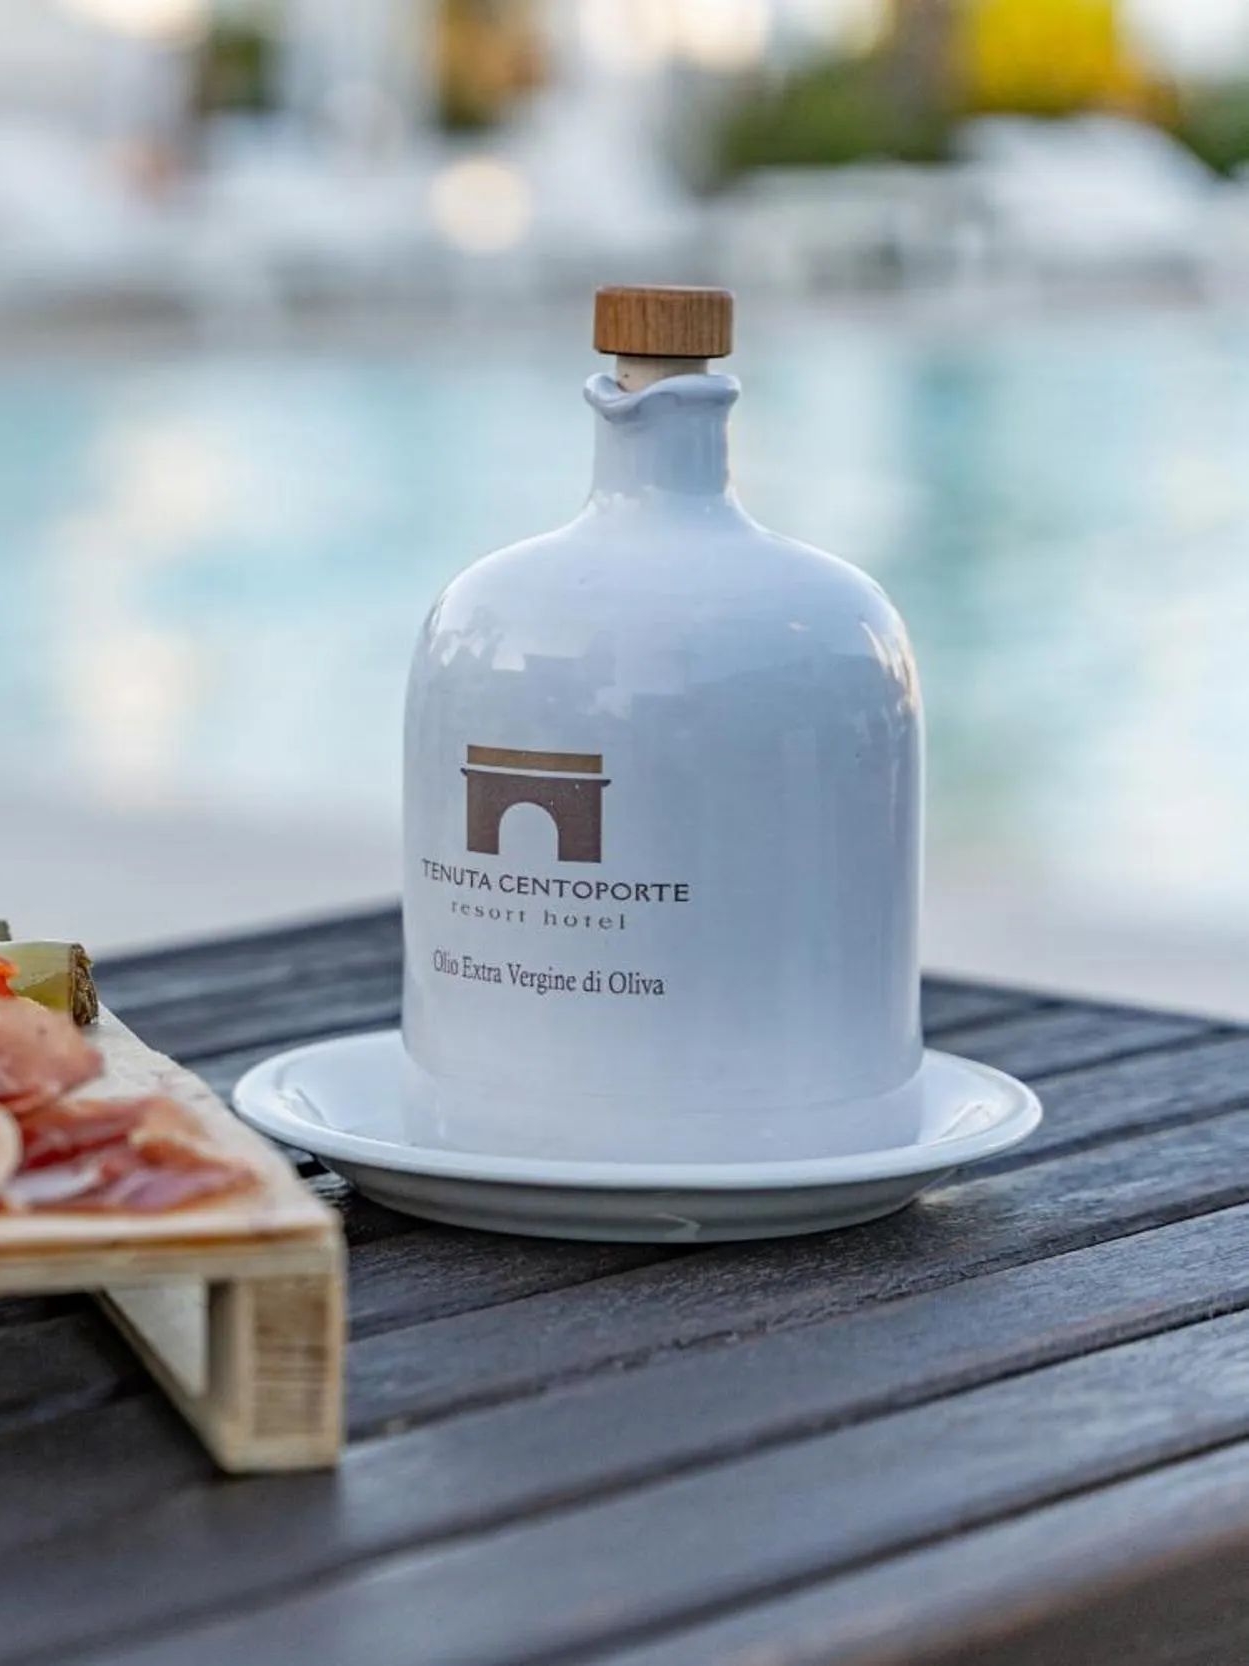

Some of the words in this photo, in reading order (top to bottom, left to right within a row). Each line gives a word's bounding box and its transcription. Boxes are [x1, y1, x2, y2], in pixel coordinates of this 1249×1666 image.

[422, 858, 491, 891] TENUTA
[499, 873, 690, 902] CENTOPORTE
[451, 901, 525, 923] resort
[543, 909, 626, 930] hotel
[433, 949, 459, 976] Olio
[462, 956, 502, 983] Extra
[507, 963, 577, 995] Vergine
[582, 970, 601, 993] di
[608, 971, 665, 996] Oliva
